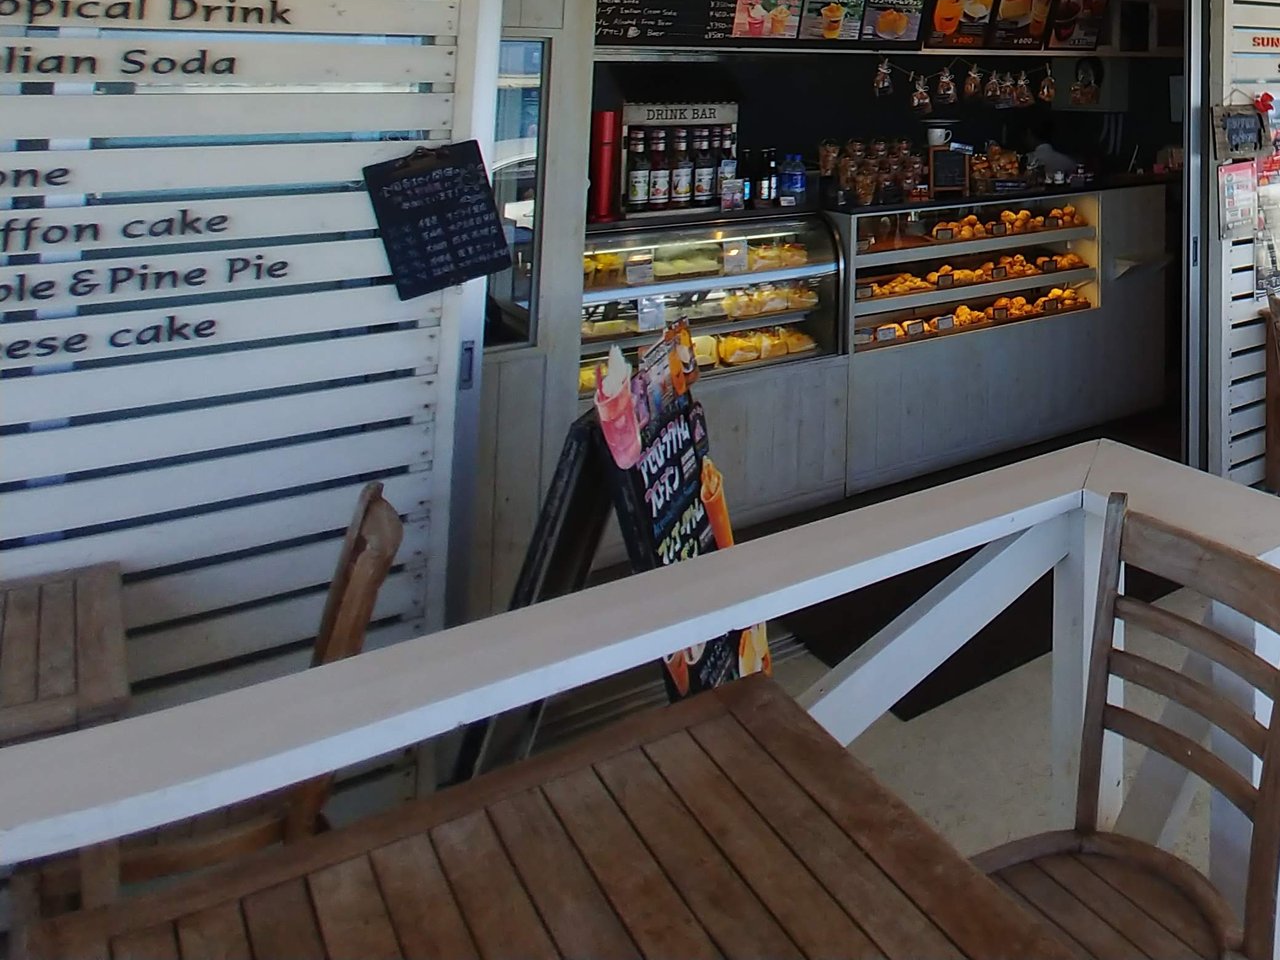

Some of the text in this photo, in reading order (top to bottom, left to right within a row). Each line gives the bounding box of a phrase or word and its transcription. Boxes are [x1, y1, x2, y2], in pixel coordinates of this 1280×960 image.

[121, 49, 237, 75] Soda
[646, 108, 717, 121] DRINK BAR
[122, 209, 230, 239] cake
[69, 269, 99, 297] &
[110, 264, 208, 294] Pine
[227, 255, 289, 283] Pie
[0, 315, 217, 360] ese cake
